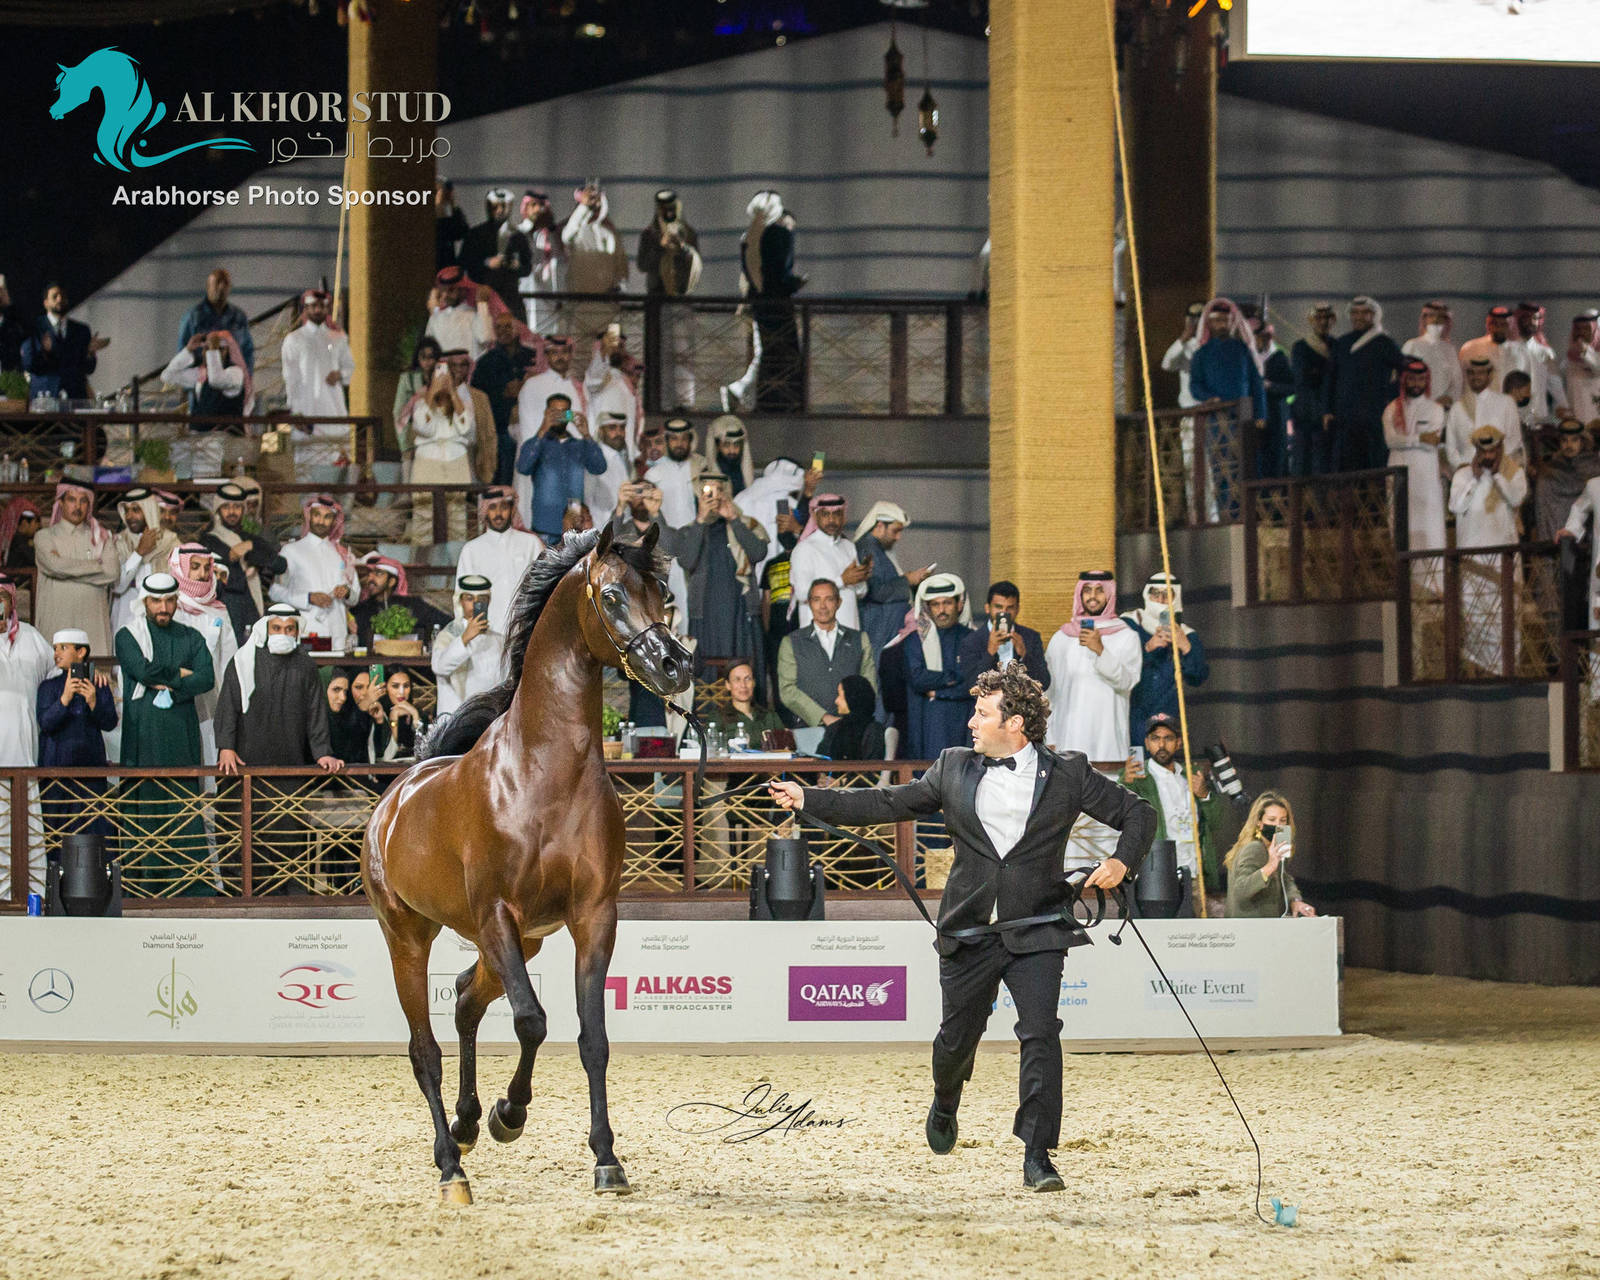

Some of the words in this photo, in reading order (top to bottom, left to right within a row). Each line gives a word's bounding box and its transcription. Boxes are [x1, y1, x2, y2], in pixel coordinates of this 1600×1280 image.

[176, 942, 204, 951] Sponsor
[288, 942, 319, 950] Platinum
[321, 942, 348, 951] Sponsor
[641, 943, 661, 951] Media
[663, 943, 691, 952] Sponsor
[810, 943, 834, 951] Official
[836, 943, 857, 951] Airline
[858, 943, 886, 952] Sponsor
[1167, 941, 1187, 949] Social
[1188, 941, 1208, 949] Media
[1209, 941, 1236, 950] Sponsor
[634, 976, 733, 994] ALKASS
[1150, 980, 1197, 995] White
[1203, 979, 1246, 995] Event
[277, 983, 359, 1009] QIC
[800, 984, 864, 1004] QATAR
